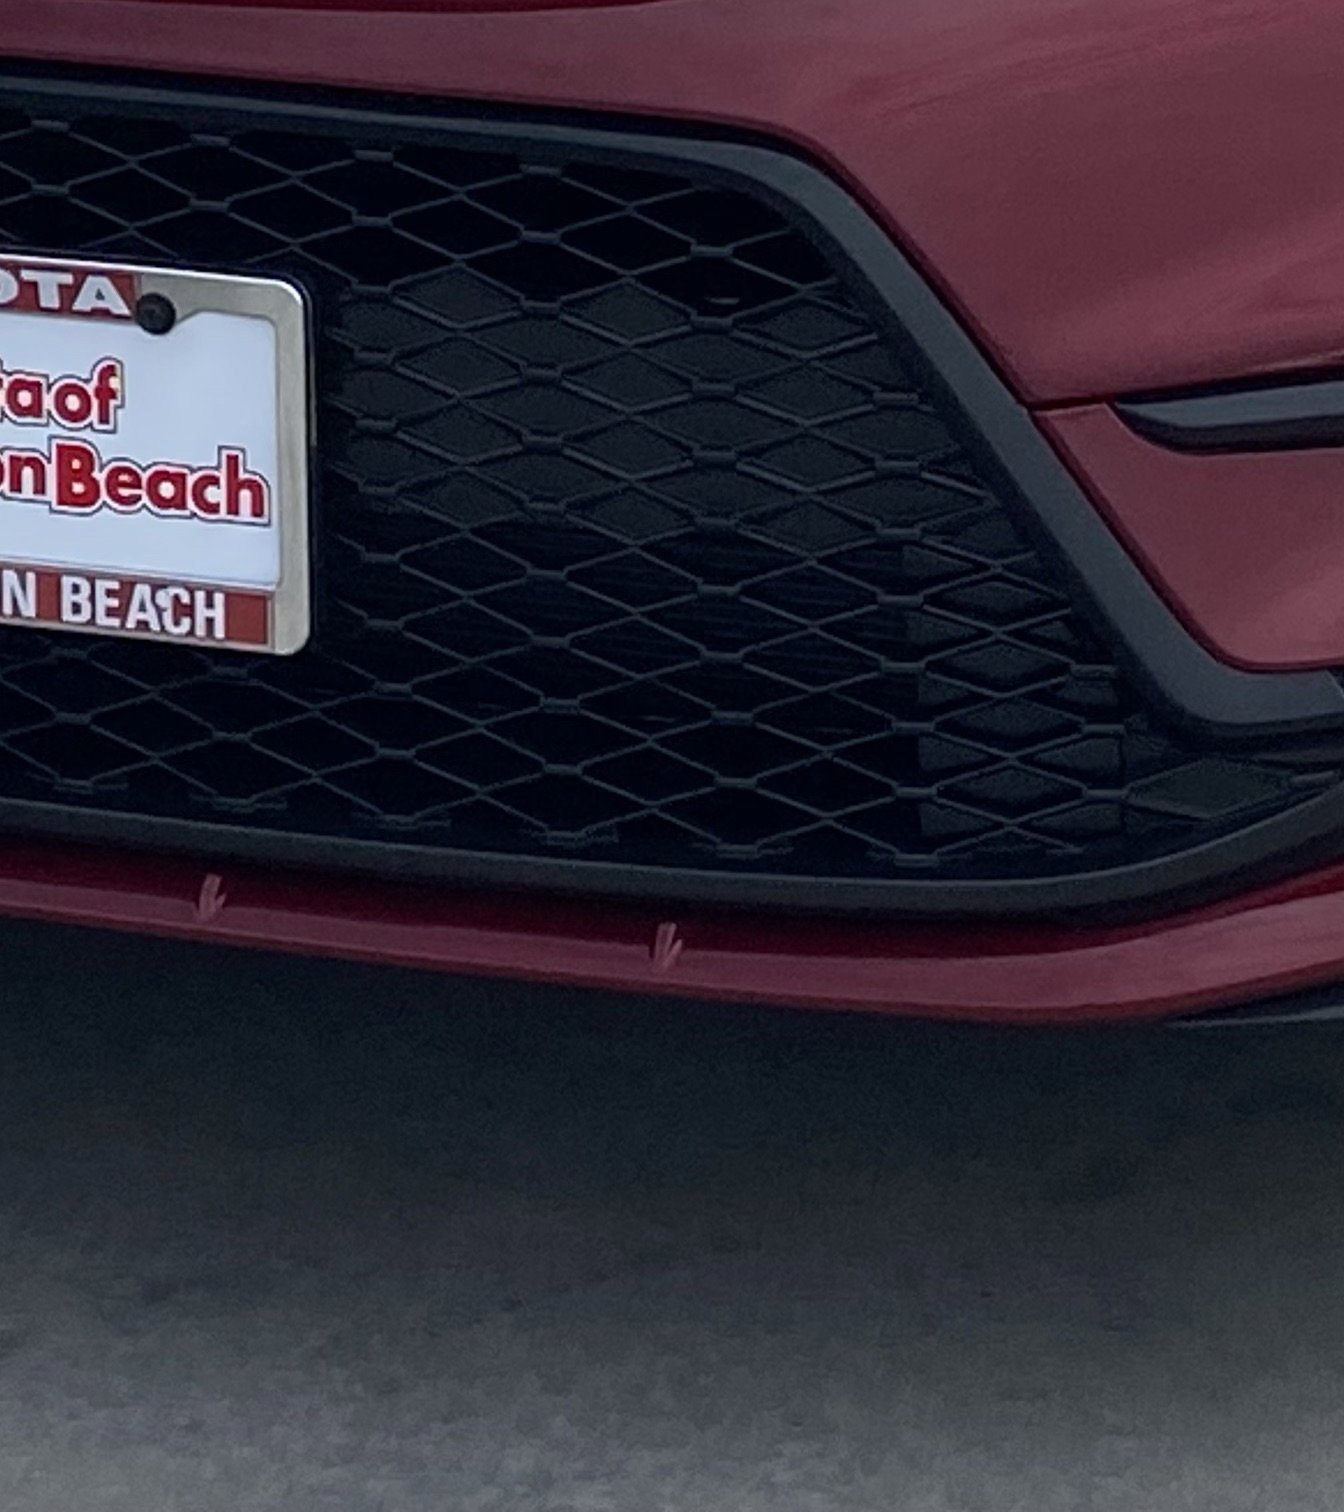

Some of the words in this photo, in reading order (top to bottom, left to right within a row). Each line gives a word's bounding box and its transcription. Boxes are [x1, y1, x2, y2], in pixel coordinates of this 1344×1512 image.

[53, 360, 119, 427] of
[54, 440, 266, 520] Beach
[60, 574, 227, 640] BEACH
